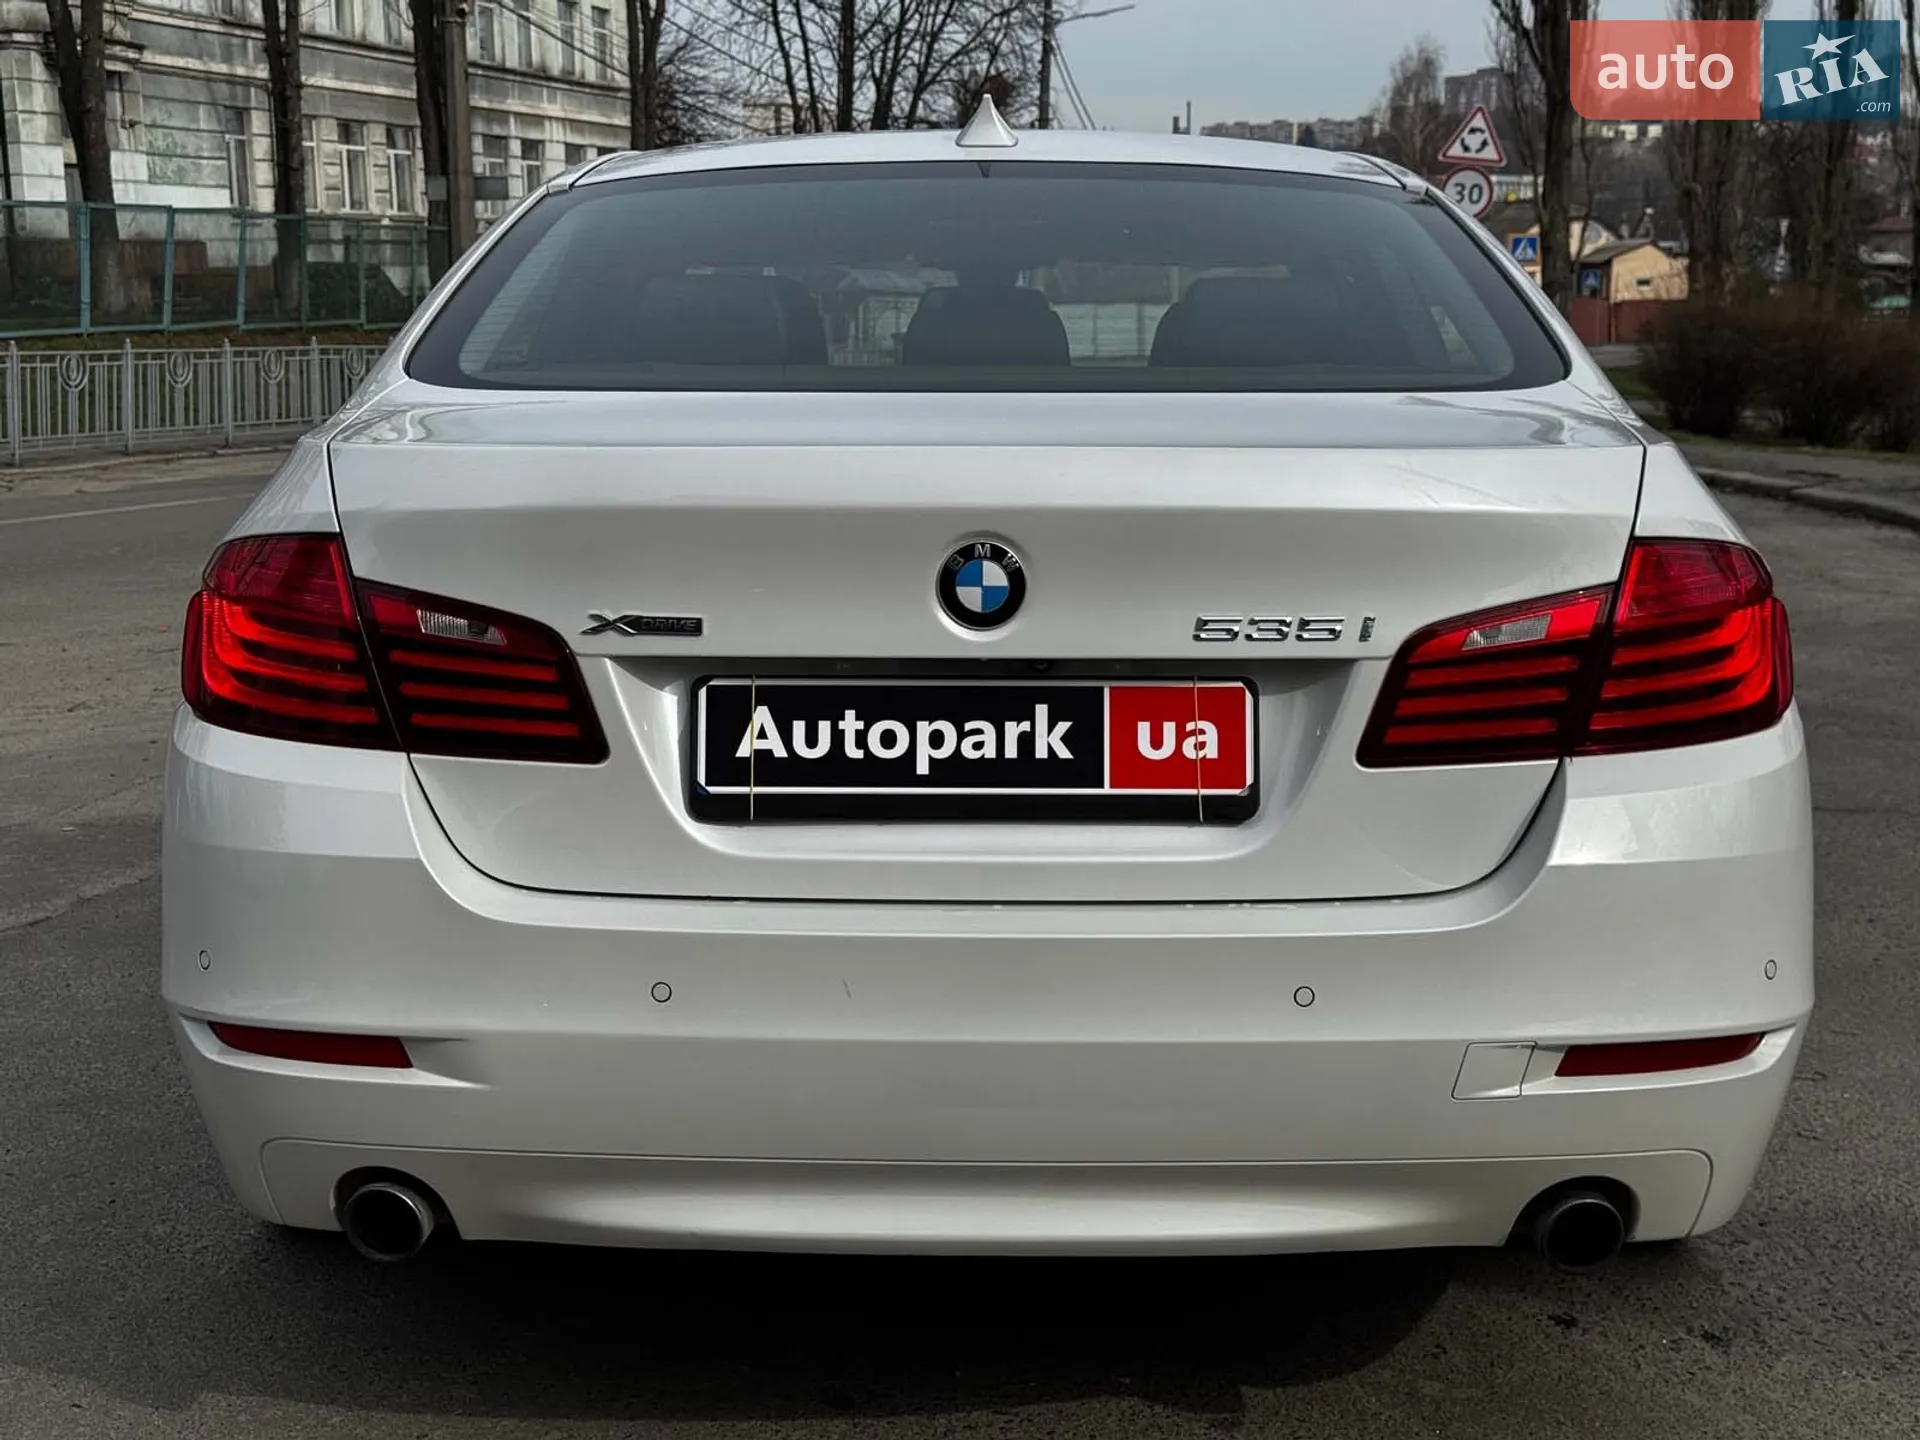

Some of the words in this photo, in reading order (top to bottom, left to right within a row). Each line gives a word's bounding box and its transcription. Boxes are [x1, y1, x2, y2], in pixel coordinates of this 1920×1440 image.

[1453, 183, 1484, 204] 30
[947, 543, 1020, 573] BMW
[1192, 616, 1376, 642] 535i
[735, 704, 1074, 775] Autopark
[1137, 720, 1218, 760] ua
